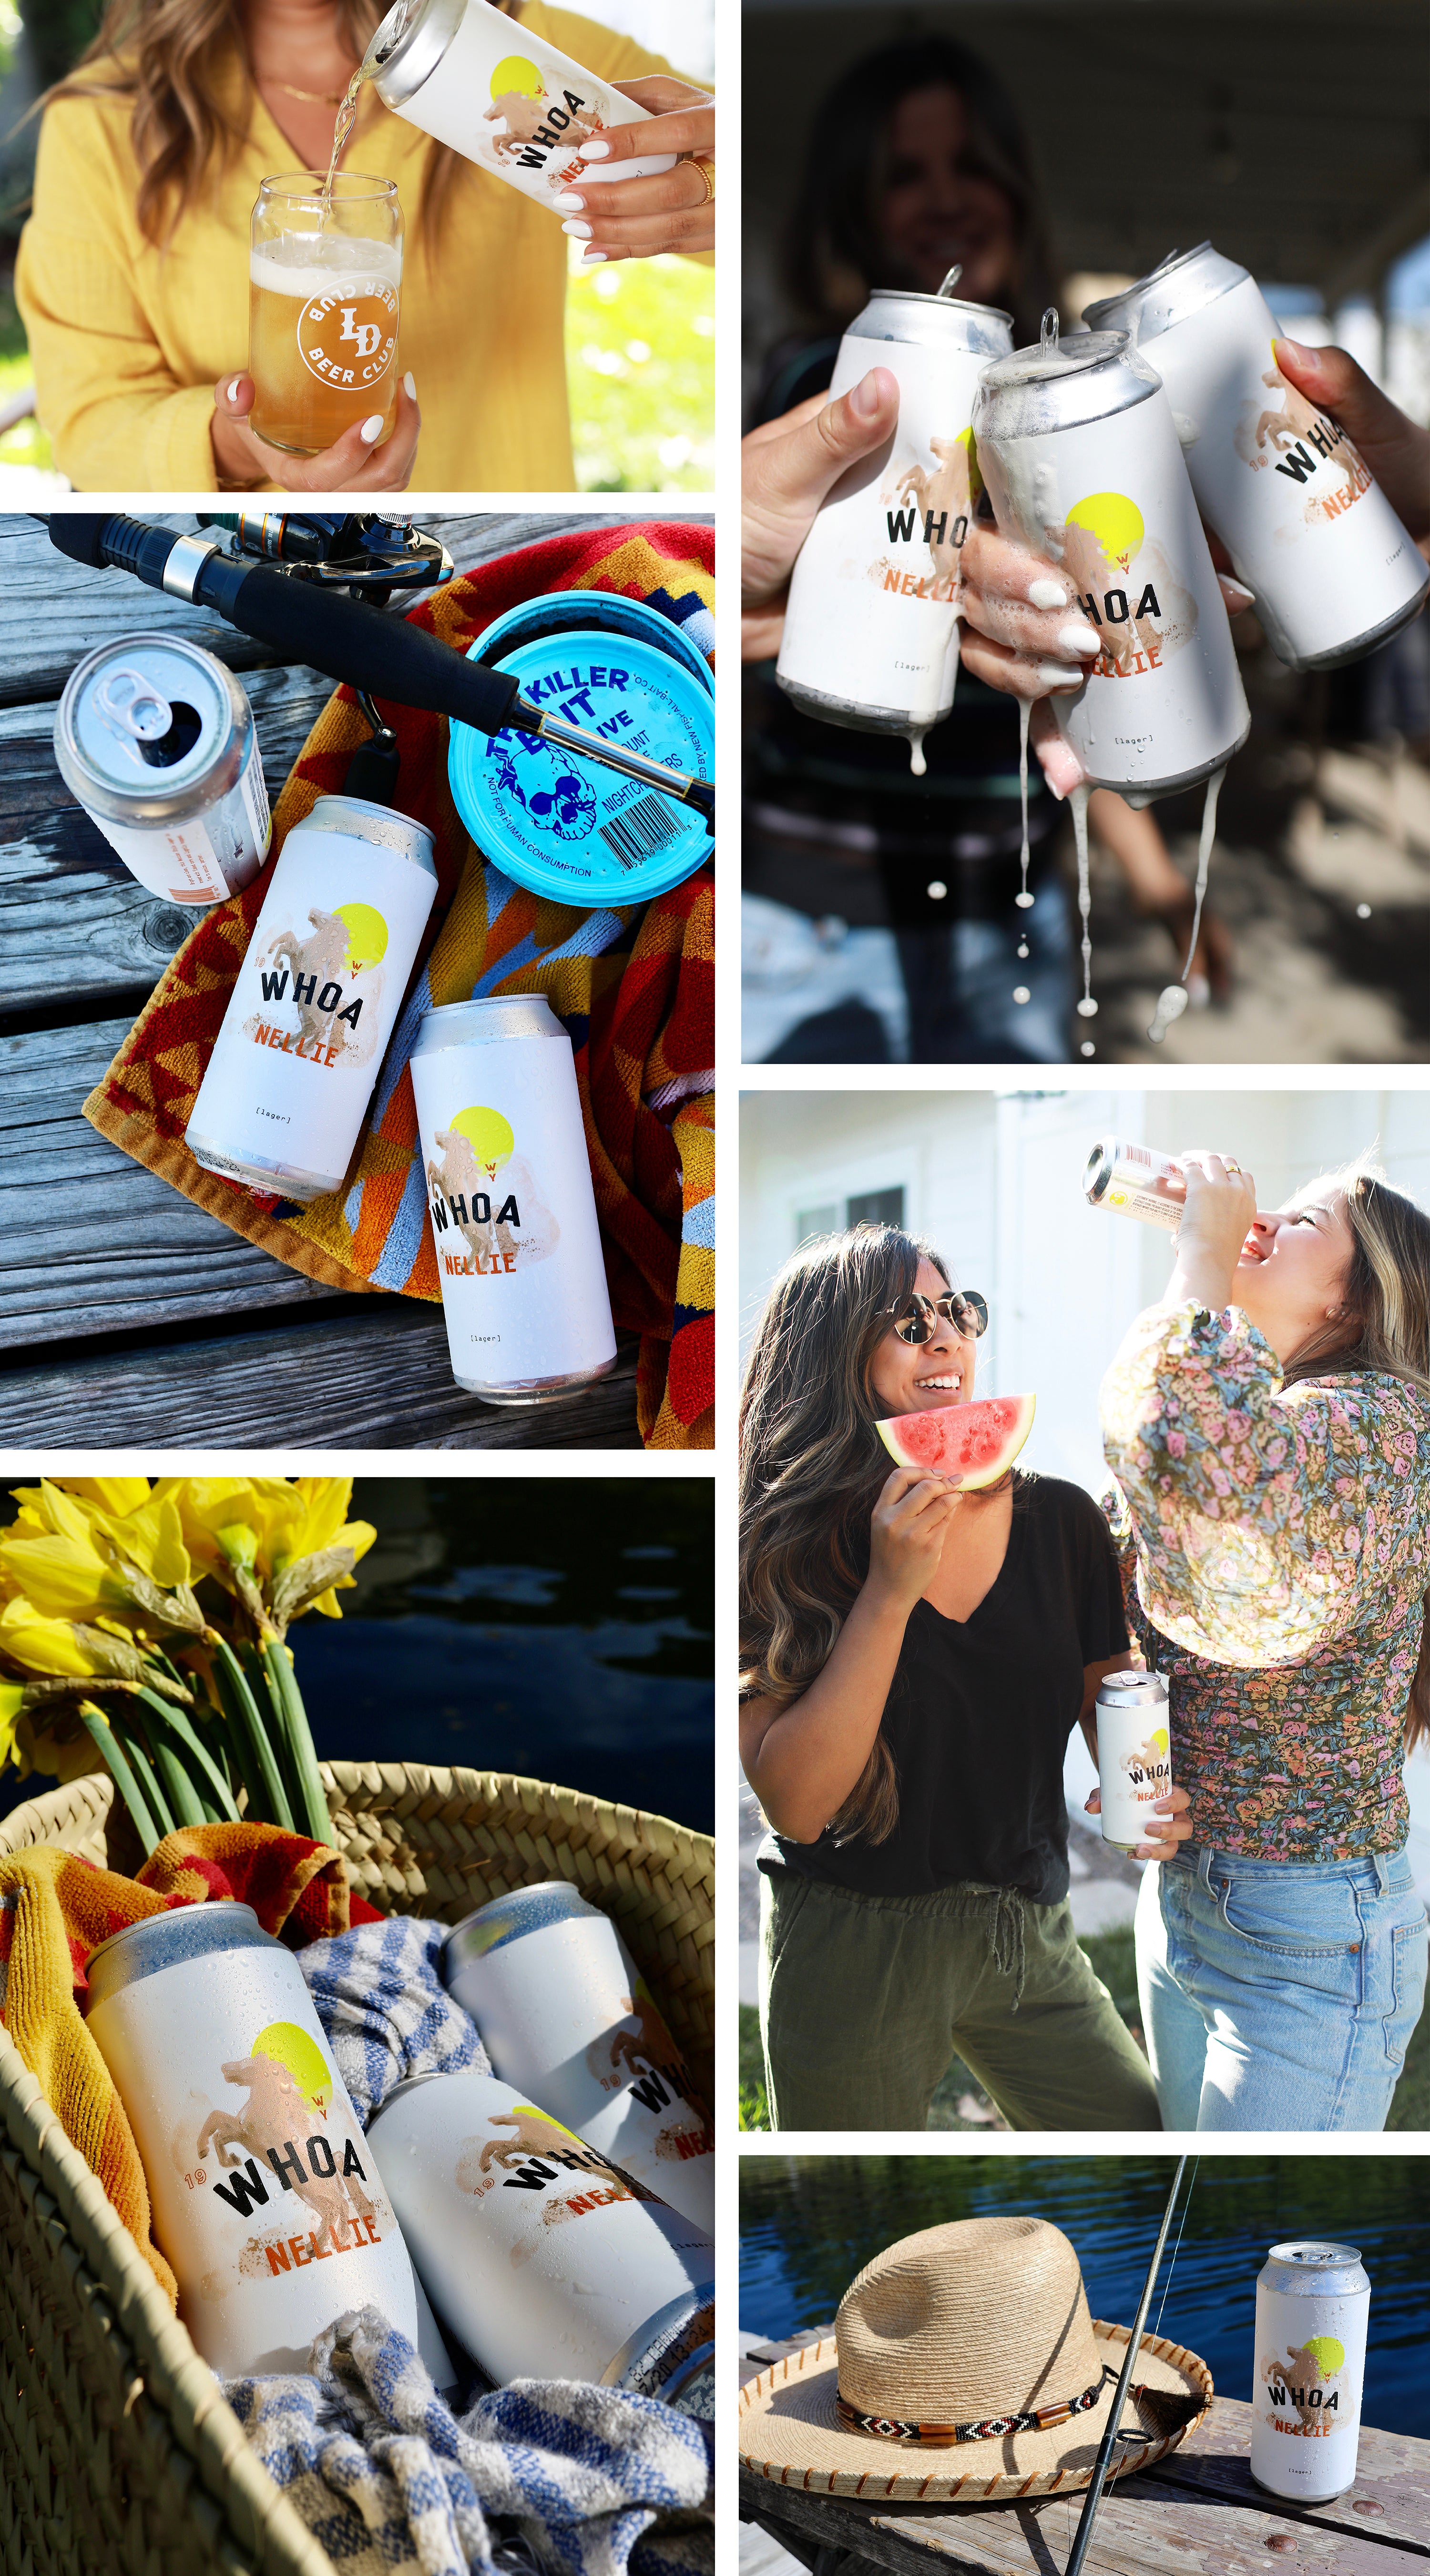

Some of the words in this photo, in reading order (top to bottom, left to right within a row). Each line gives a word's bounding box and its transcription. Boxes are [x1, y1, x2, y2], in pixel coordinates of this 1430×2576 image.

[516, 90, 585, 169] WHOA
[308, 284, 357, 322] CLUB
[365, 281, 396, 313] BEER
[308, 347, 355, 383] BEER
[363, 336, 395, 379] CLUB
[1249, 455, 1269, 472] 19
[887, 508, 968, 548] WHO
[884, 569, 958, 602] NELLI
[1077, 584, 1161, 625] HOA
[1090, 645, 1163, 678] ELLIE
[524, 666, 629, 705] KILLER
[515, 687, 596, 756] BIT
[596, 710, 634, 739] IVE
[621, 730, 650, 751] OUNT
[688, 731, 702, 751] NEW
[1115, 734, 1154, 745] [lager]
[487, 777, 499, 795] NOT
[492, 797, 506, 816] FOR
[502, 816, 528, 845] HUMAN
[527, 844, 592, 877] CONSUMPTION
[254, 956, 266, 968] 19
[261, 970, 364, 1030] WHOA
[254, 1024, 339, 1068] NELLIE
[256, 1106, 291, 1125] [lager]
[430, 1193, 521, 1233] WHOA
[444, 1252, 517, 1277] NELLIE
[470, 1335, 501, 1343] [lager]
[1129, 1763, 1169, 1784] WHOA
[1137, 1786, 1168, 1802] NELLIE
[600, 2075, 622, 2091] 19
[628, 2063, 699, 2114] WHO
[184, 2169, 207, 2190] 19
[213, 2135, 367, 2218] WHOA
[503, 2148, 614, 2191] WHO
[474, 2178, 495, 2198] 19
[264, 2215, 381, 2276] NELLIE
[1267, 2386, 1339, 2411] WHOA
[1275, 2419, 1330, 2437] NELLIE
